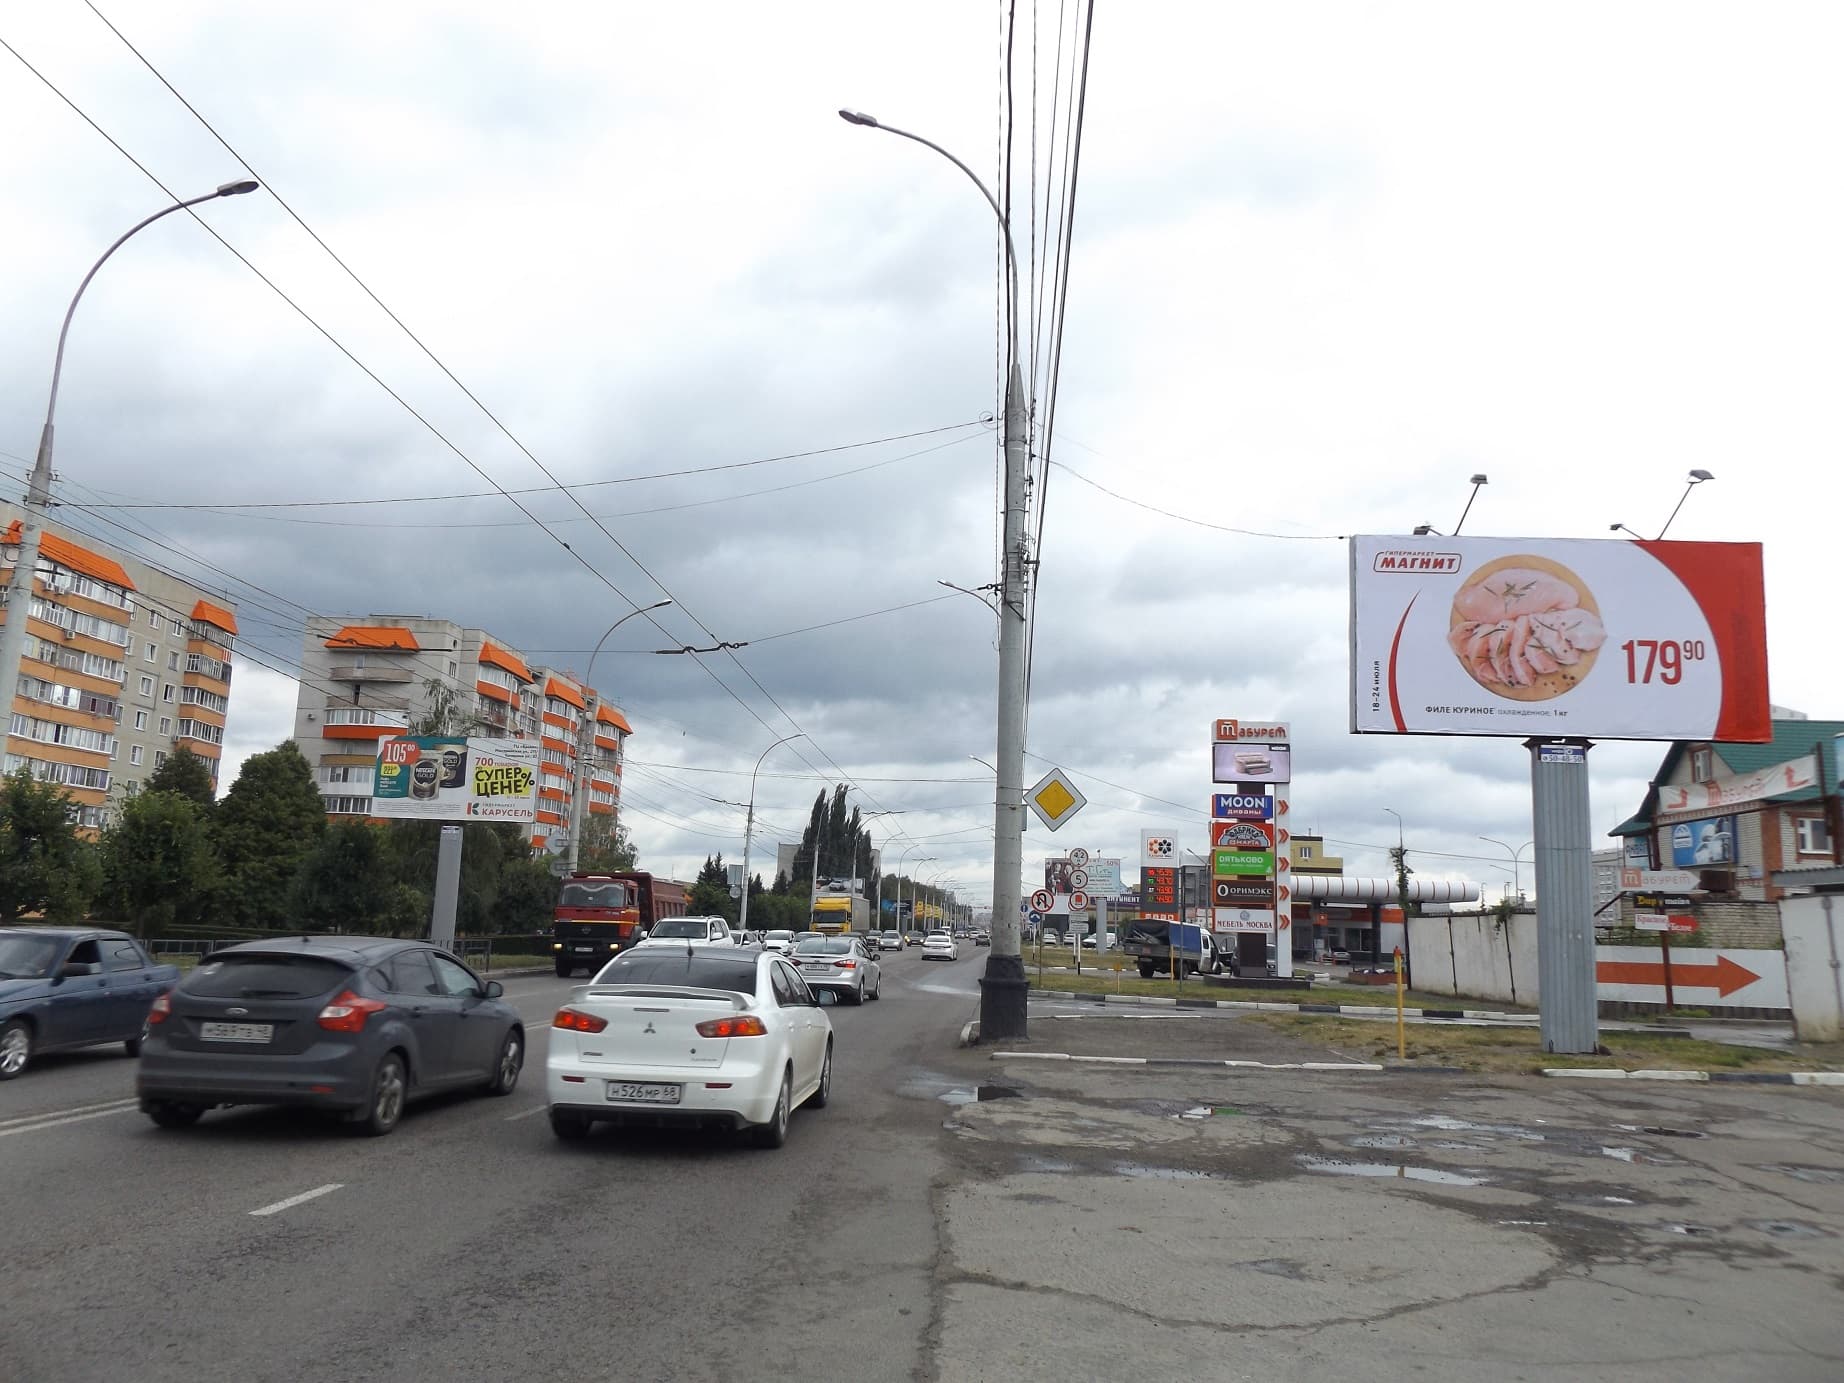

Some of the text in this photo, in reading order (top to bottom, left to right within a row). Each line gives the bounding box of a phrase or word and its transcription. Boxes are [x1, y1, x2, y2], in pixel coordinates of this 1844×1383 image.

[1380, 556, 1457, 571] МАГНИТ
[1621, 639, 1683, 686] 179
[1372, 660, 1381, 685] июля
[1425, 706, 1451, 715] ФИЛЕ
[1452, 707, 1495, 716] КУРИНОЕ
[385, 743, 407, 762] 105
[475, 757, 494, 767] 700
[475, 767, 523, 782] СУПЕР
[476, 780, 523, 798] ЦЕНЕ
[1220, 796, 1265, 808] MOON
[481, 808, 534, 817] КАРУСЕЛЬ
[1075, 875, 1082, 885] 5
[1230, 887, 1273, 895] ОРИМЭКС
[1217, 920, 1273, 929] МЕБЕЛЬ МОСКВА
